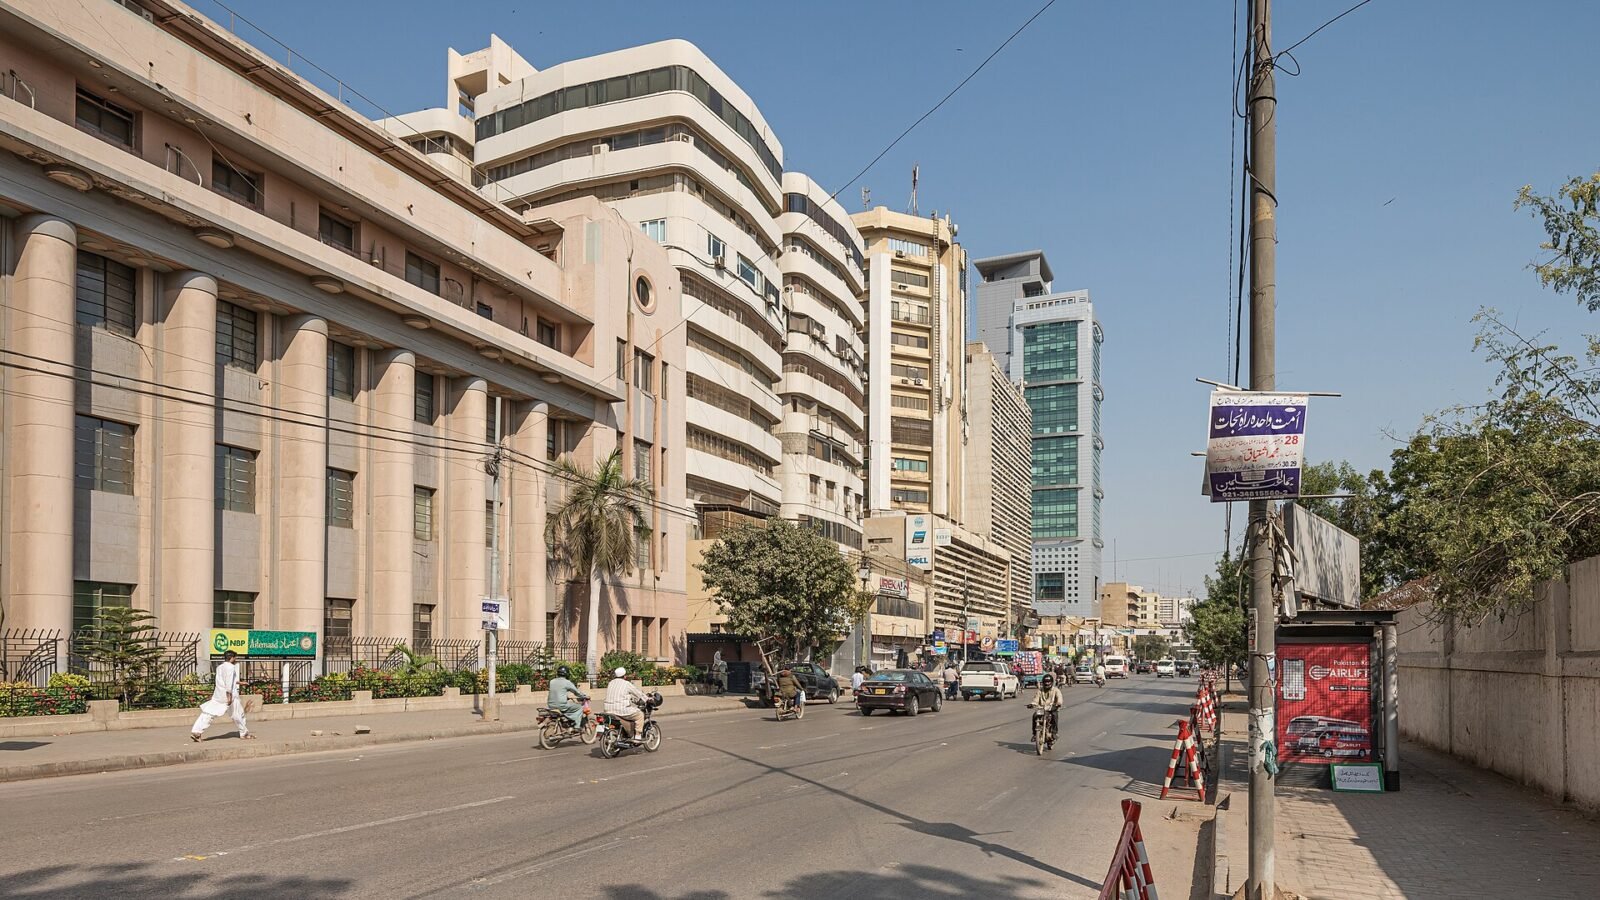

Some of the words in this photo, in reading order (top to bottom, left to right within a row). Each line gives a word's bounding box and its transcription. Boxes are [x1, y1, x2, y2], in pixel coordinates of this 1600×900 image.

[1284, 435, 1299, 445] 28
[908, 557, 928, 565] DELL
[229, 639, 246, 647] NBP
[1329, 668, 1370, 678] AIRLIFT
